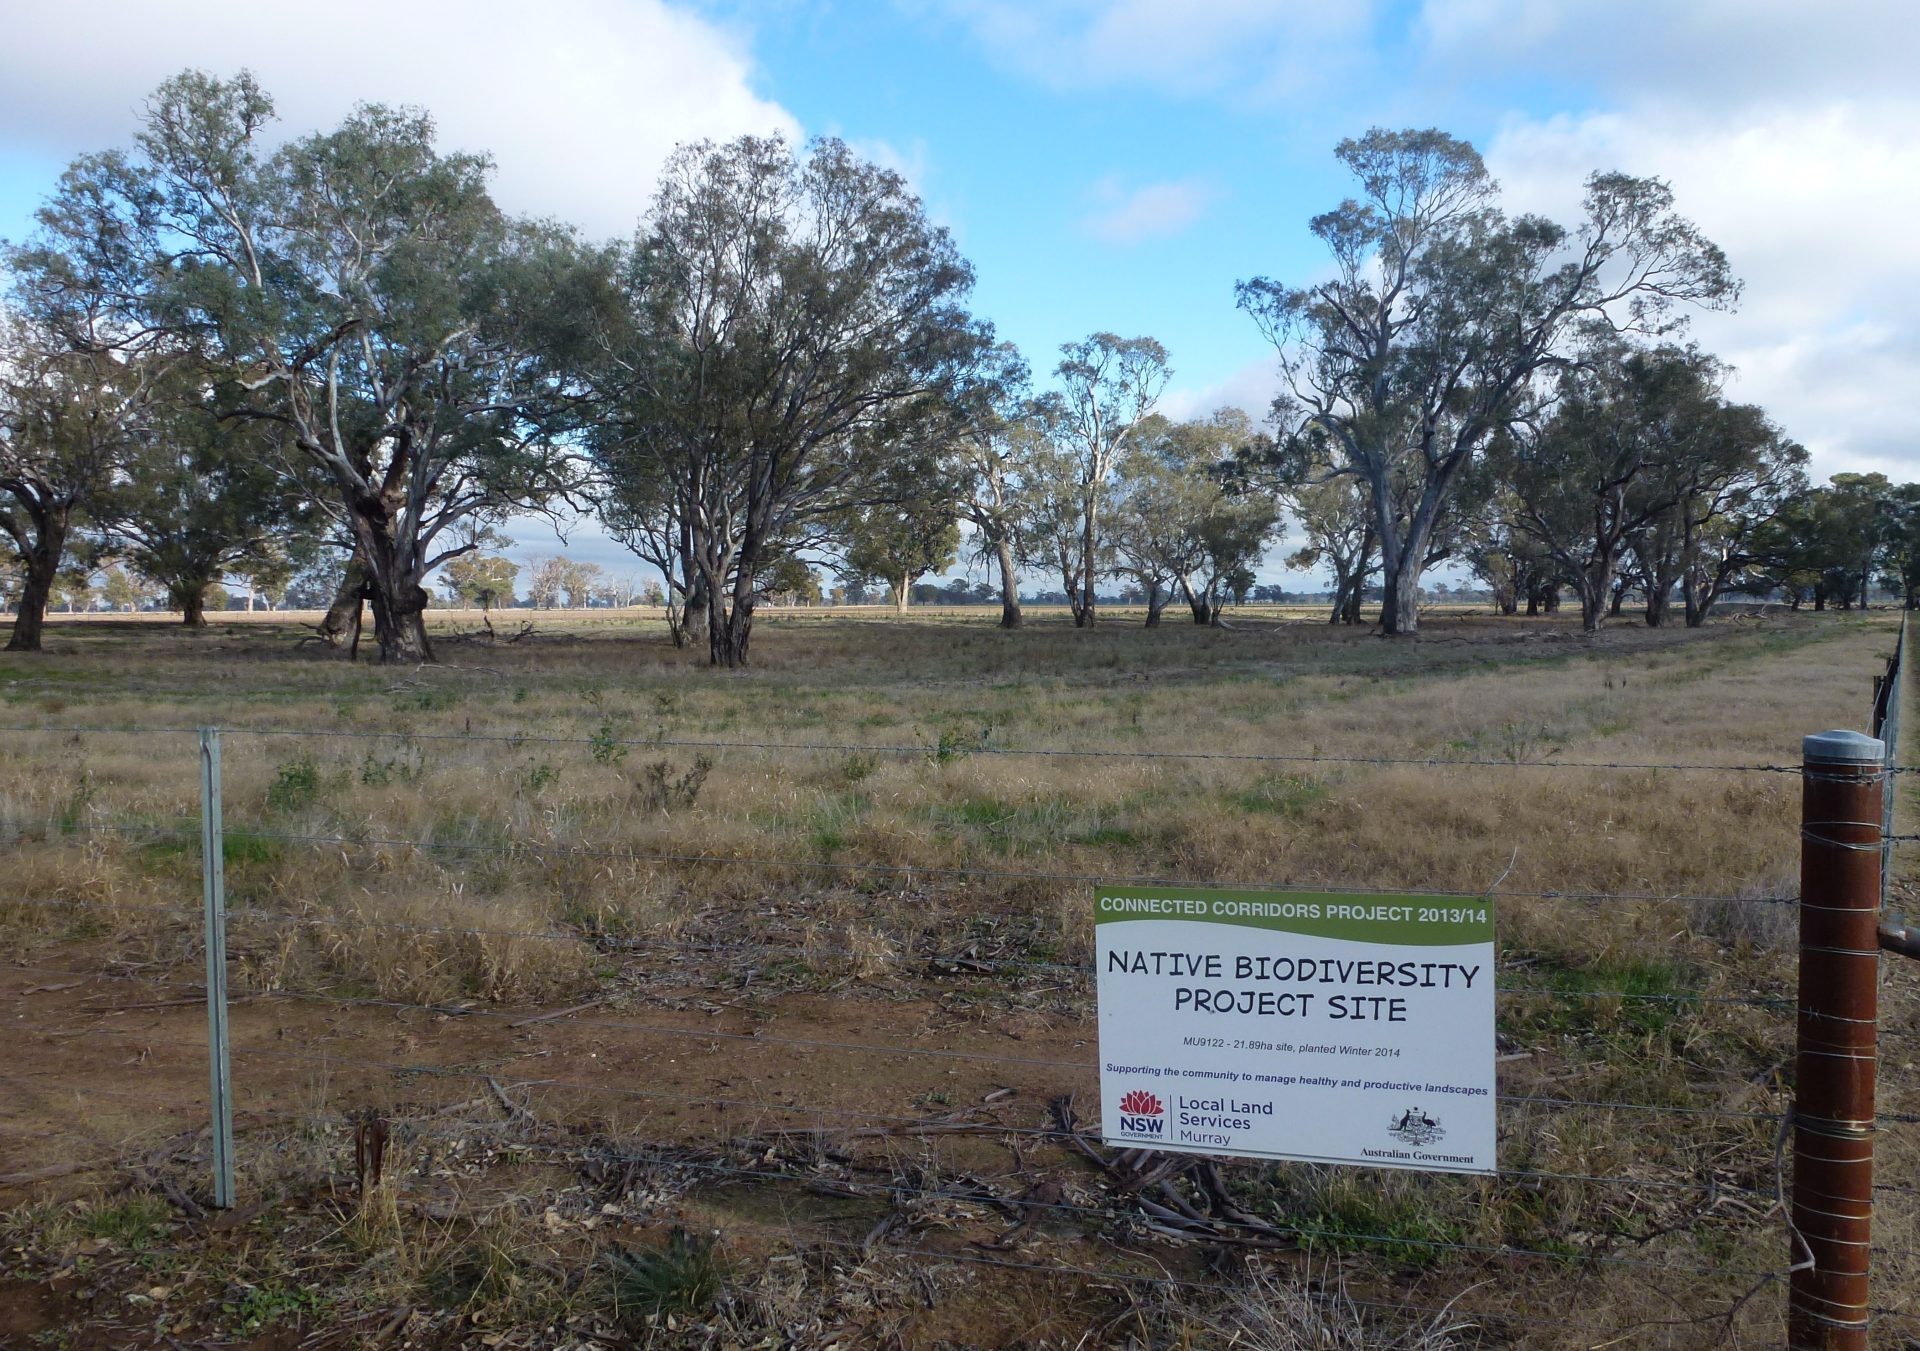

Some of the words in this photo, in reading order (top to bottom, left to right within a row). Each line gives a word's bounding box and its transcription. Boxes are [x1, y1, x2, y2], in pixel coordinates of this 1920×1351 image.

[1100, 897, 1207, 915] CONNECTED
[1212, 901, 1320, 919] CORRIDORS
[1326, 905, 1413, 921] PROJECT
[1418, 908, 1487, 923] 2013/14
[1108, 950, 1222, 978] NATIVE
[1235, 956, 1480, 988] BIODIVERSITY
[1175, 988, 1314, 1017] PROJECT
[1328, 995, 1407, 1021] SITE
[1183, 1036, 1224, 1047] MU9122
[1233, 1040, 1273, 1051] 21.89ha
[1275, 1043, 1295, 1053] site,
[1298, 1043, 1337, 1055] planted
[1339, 1045, 1372, 1056] Winter
[1374, 1047, 1401, 1058] 2014
[1106, 1063, 1161, 1077] Supporting
[1164, 1067, 1179, 1076] the
[1182, 1070, 1239, 1082] community
[1242, 1072, 1252, 1081] to
[1255, 1075, 1296, 1086] manage
[1299, 1076, 1338, 1088] healthy
[1341, 1079, 1361, 1088] and
[1363, 1080, 1422, 1092] productive
[1424, 1083, 1488, 1096] landscapes
[1179, 1095, 1224, 1112] Local
[1231, 1099, 1273, 1115] Land
[1120, 1116, 1164, 1133] NSW
[1179, 1112, 1251, 1130] Services
[1120, 1131, 1163, 1140] GOVERNMENT
[1180, 1130, 1231, 1147] Murray
[1360, 1147, 1410, 1160] Australian
[1413, 1151, 1474, 1164] Government
